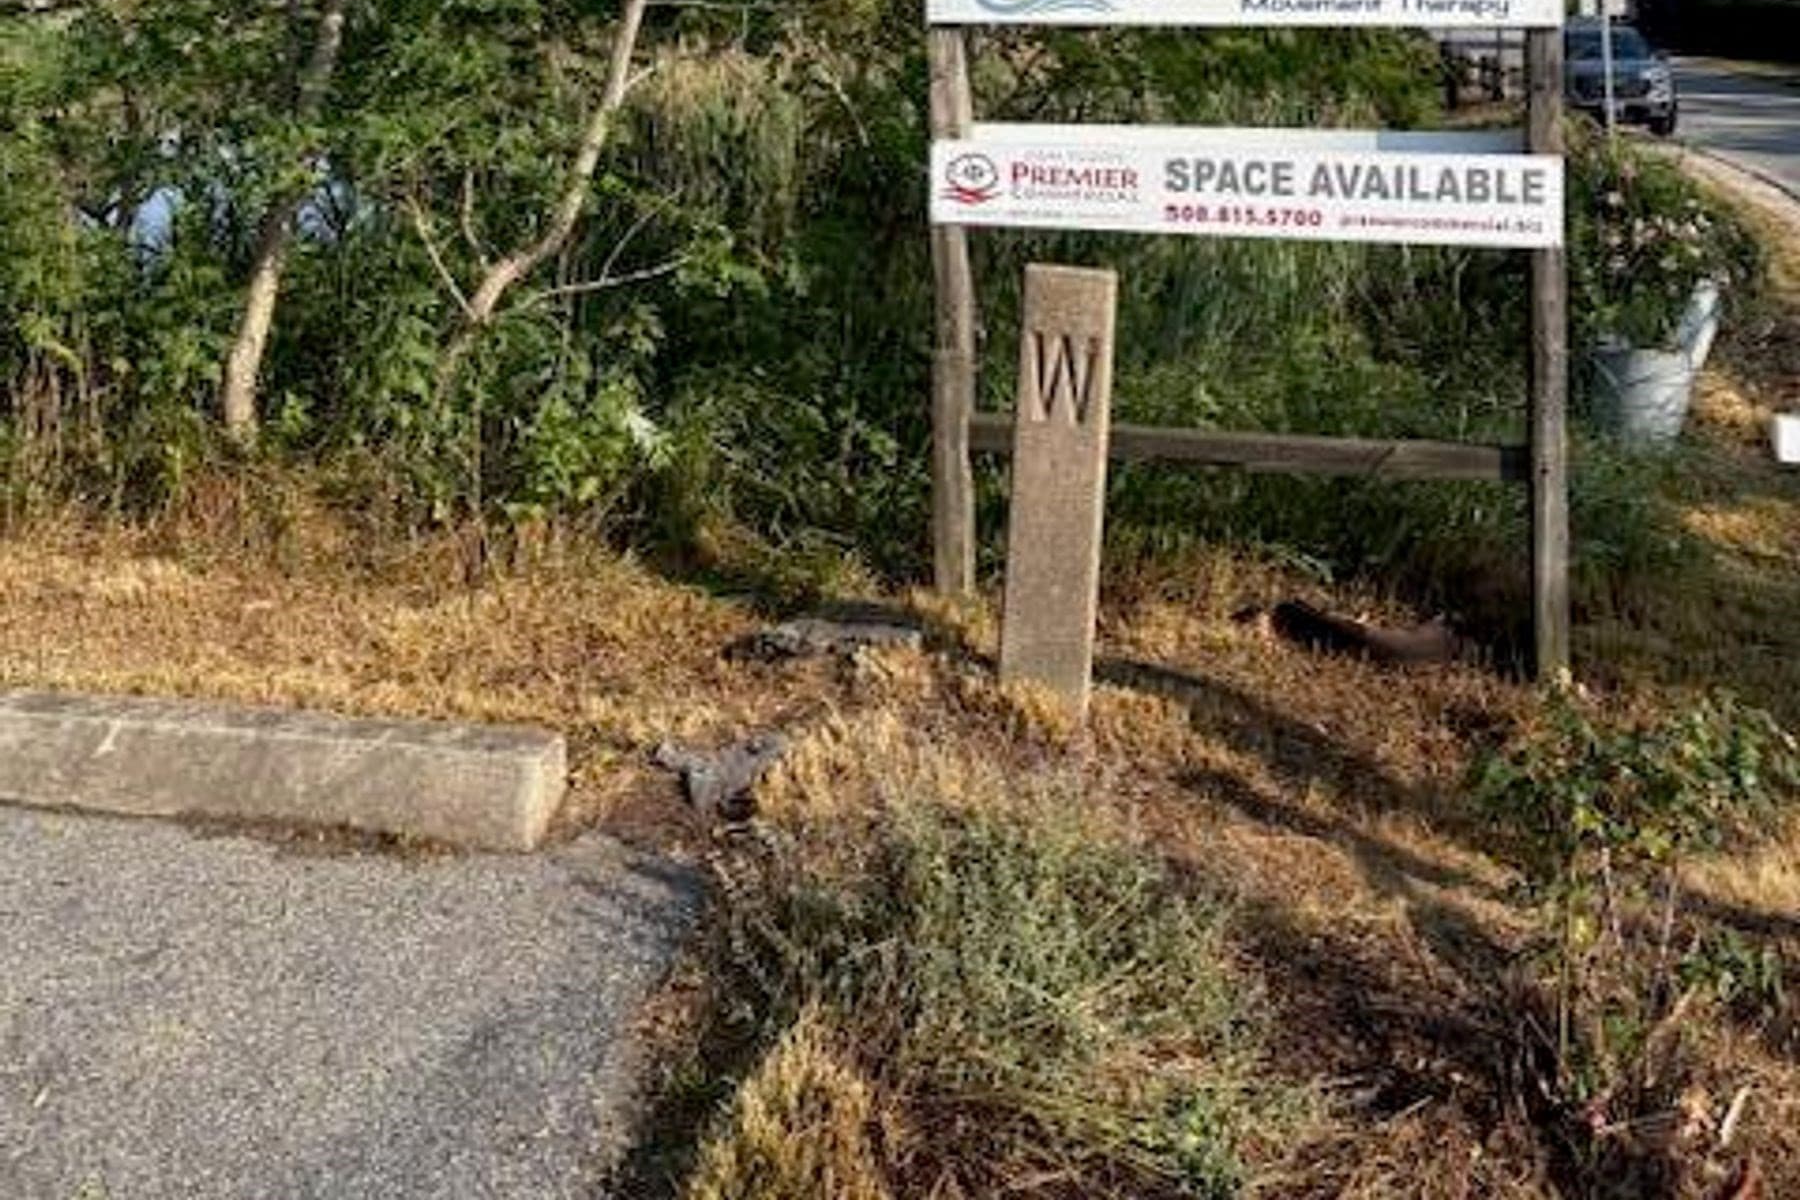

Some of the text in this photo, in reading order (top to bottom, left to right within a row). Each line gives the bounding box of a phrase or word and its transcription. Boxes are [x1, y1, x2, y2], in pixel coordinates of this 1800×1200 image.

[1011, 161, 1139, 189] PREMIER
[1165, 156, 1546, 205] SPACE AVAILABLE
[1028, 330, 1103, 424] W
